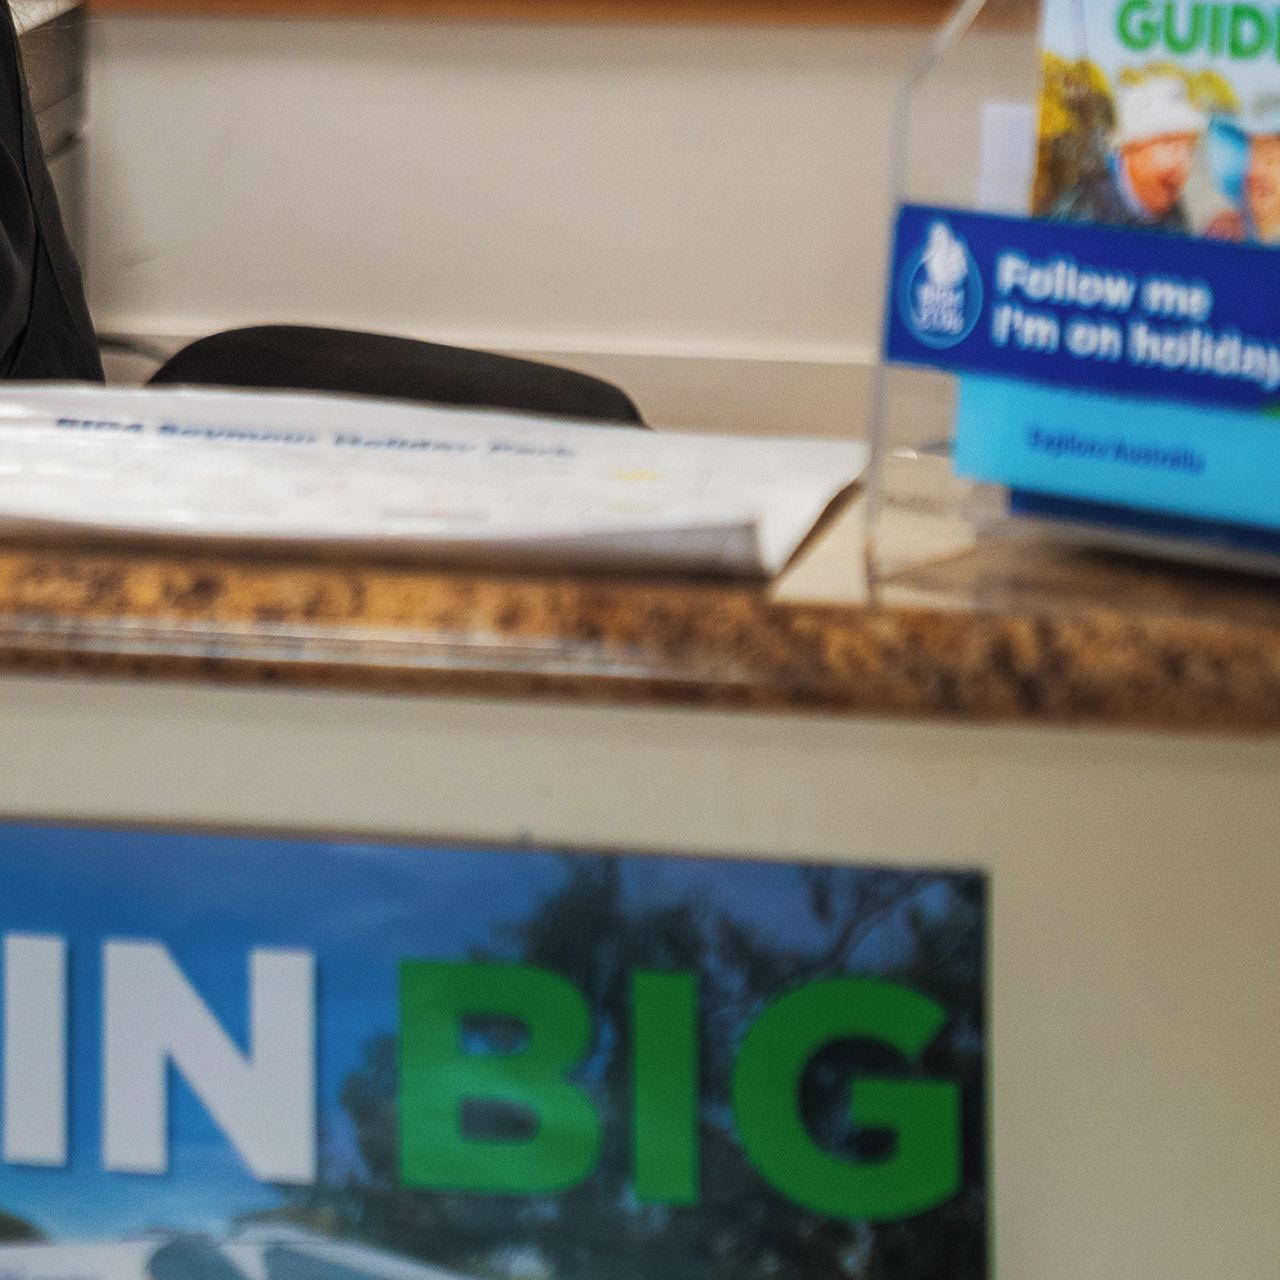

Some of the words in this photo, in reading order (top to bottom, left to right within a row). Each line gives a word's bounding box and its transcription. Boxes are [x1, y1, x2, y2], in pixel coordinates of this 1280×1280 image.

[997, 251, 1138, 310] Follow
[1144, 279, 1211, 321] me
[992, 305, 1060, 352] I'm
[1066, 321, 1123, 361] on
[396, 956, 962, 1224] BIG
